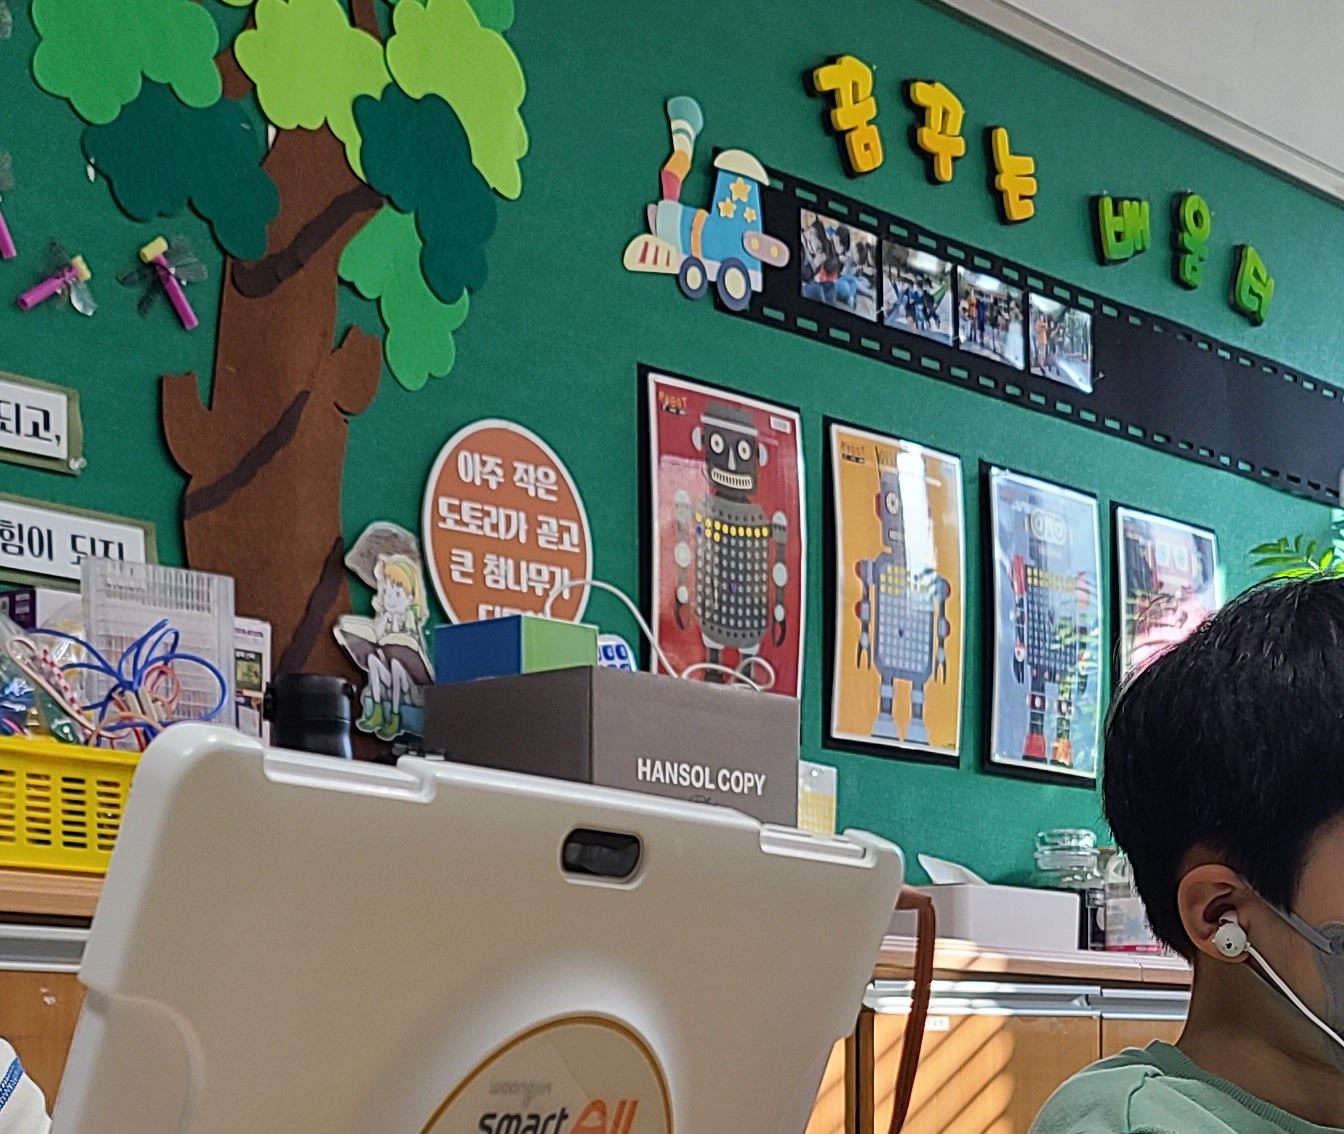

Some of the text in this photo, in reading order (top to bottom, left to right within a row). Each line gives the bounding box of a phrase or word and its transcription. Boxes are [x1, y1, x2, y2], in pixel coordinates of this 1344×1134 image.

[813, 55, 1276, 325] 꿈꾸는 배움터
[457, 449, 559, 502] 아주 작은
[437, 496, 581, 553] 도토리가 곧고
[449, 548, 572, 601] 큰 참나무가
[637, 757, 766, 796] HANSOL COPY
